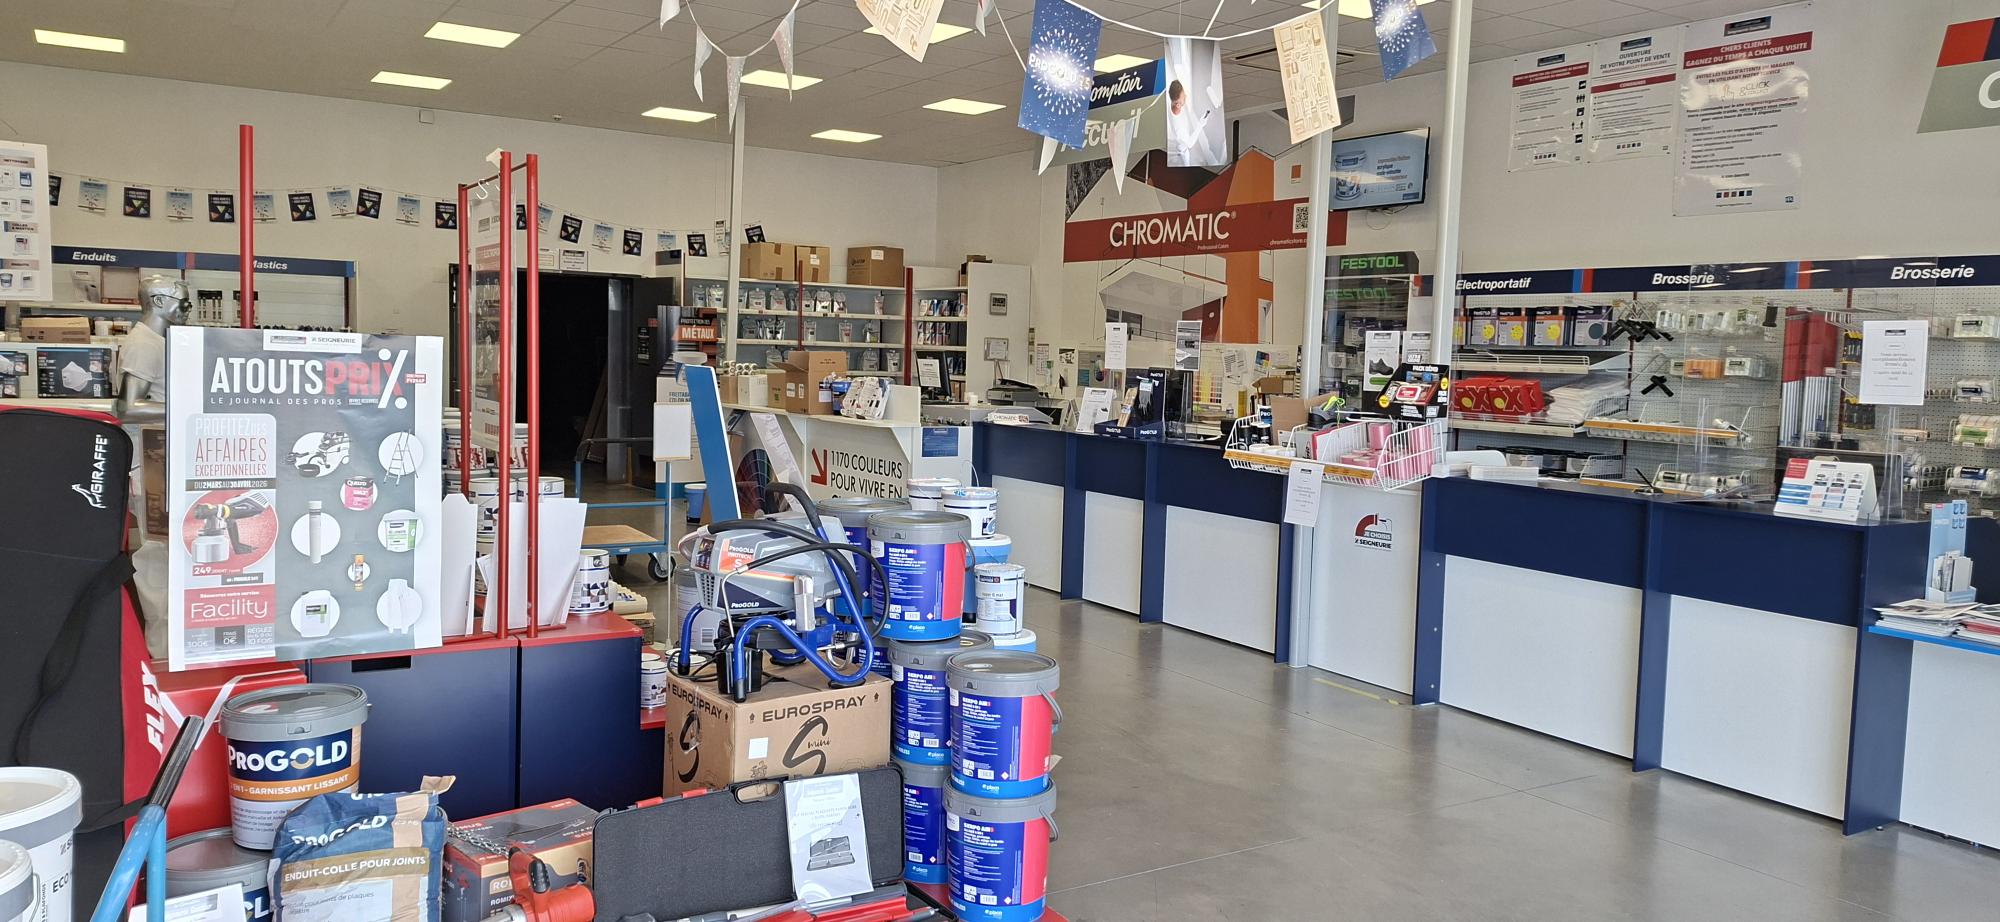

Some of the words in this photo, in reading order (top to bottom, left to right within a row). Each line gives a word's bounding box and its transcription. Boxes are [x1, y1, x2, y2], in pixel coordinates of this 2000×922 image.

[1720, 44, 1742, 53] CHERS
[1743, 39, 1772, 49] CLIENTS
[1652, 53, 1671, 62] VENTE
[1090, 71, 1143, 104] omptoir
[72, 250, 117, 264] Enduits
[1340, 255, 1405, 271] FESTOOL
[1651, 271, 1715, 286] Brosserie
[1889, 264, 1976, 281] Brosserie
[1456, 276, 1532, 292] Electroportatif
[681, 325, 715, 340] MÉTAUX
[210, 397, 223, 405] LE
[228, 397, 281, 406] JOURNAL
[287, 397, 308, 406] DES
[313, 398, 342, 406] PROS
[195, 438, 267, 463] AFFAIRES
[194, 464, 267, 477] EXCEPTIONNELLES
[831, 450, 850, 470] 1170
[851, 454, 903, 480] COULEURS
[830, 471, 856, 494] POUR
[858, 478, 886, 499] VIVRE
[1359, 538, 1392, 550] SEIGNEURIE
[194, 567, 212, 575] 249
[191, 598, 268, 619] Facility
[924, 673, 937, 681] AIR
[140, 660, 166, 753] FLEX
[762, 694, 867, 723] EUROSPRAY
[978, 700, 992, 708] AIR
[807, 737, 832, 749] mini
[313, 773, 350, 791] LISSANT
[980, 826, 995, 834] AIR
[284, 861, 358, 882] ENDUIT-COLLE
[359, 857, 391, 870] POUR
[391, 855, 427, 868] JOINTS
